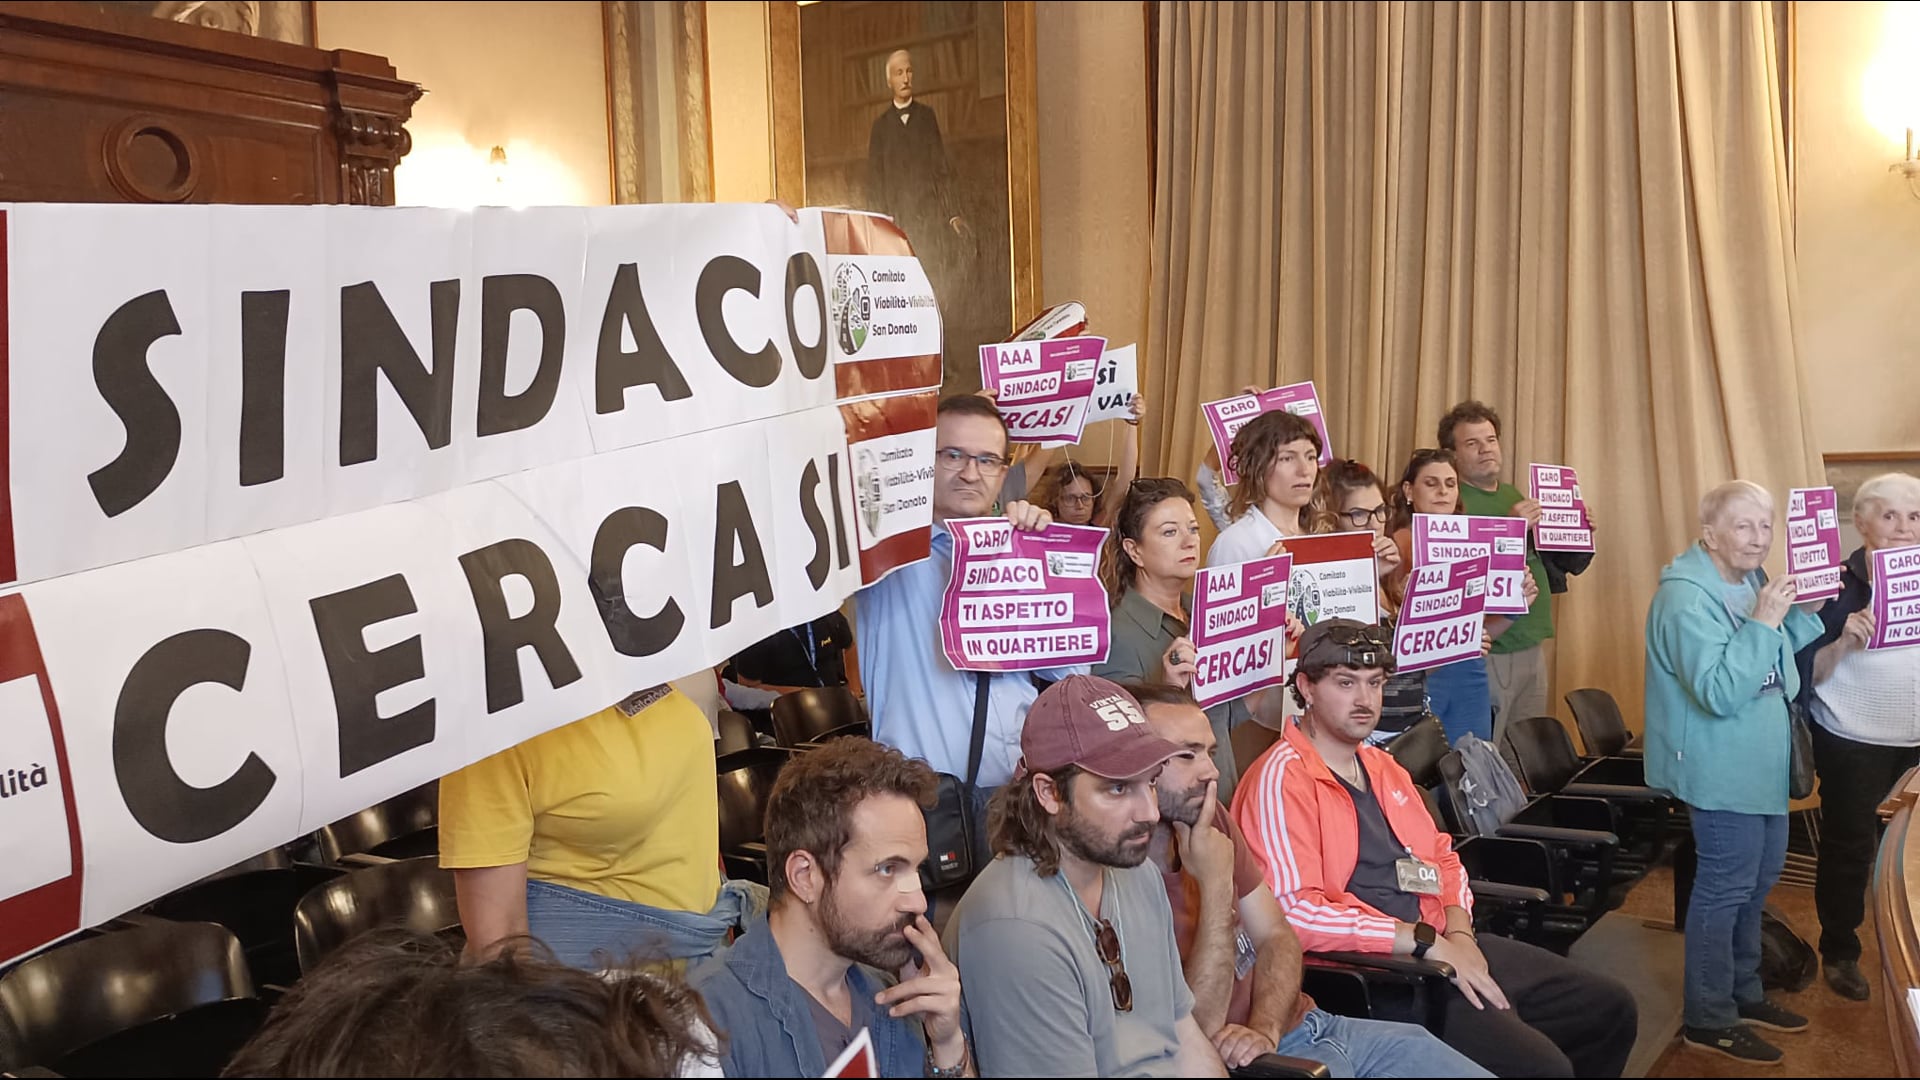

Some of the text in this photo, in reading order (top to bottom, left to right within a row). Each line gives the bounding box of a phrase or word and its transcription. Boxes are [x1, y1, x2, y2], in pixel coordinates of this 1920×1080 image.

[872, 270, 906, 282] Comitato
[872, 322, 918, 336] San Donato
[1000, 349, 1033, 366] AAA
[1096, 360, 1118, 385] SÌ
[86, 251, 828, 518] SINDACO
[1003, 377, 1057, 397] SINDACO
[1097, 392, 1132, 411] VA!
[1221, 400, 1256, 416] CARO
[1540, 472, 1559, 483] CARO
[1541, 492, 1571, 503] SINDACO
[1429, 520, 1461, 534] AAA
[973, 528, 1010, 550] CARO
[1431, 546, 1487, 559] SINDACO
[1889, 554, 1920, 570] CARO
[966, 565, 1040, 586] SINDACO
[1208, 571, 1236, 594] AAA
[1319, 571, 1347, 582] Comitato
[1416, 570, 1444, 586] AAA
[963, 600, 1068, 621] TI ASPETTO
[1323, 604, 1356, 616] San Donato
[1414, 593, 1460, 613] SINDACO
[1891, 605, 1904, 617] TI
[1208, 604, 1256, 630] SINDACO
[1400, 621, 1477, 656] CERCASI
[1888, 627, 1902, 639] IN
[112, 452, 852, 844] CERCASI
[966, 633, 1093, 656] IN QUARTIERE
[1195, 637, 1275, 688] CERCASI
[1095, 700, 1146, 731] 55
[1418, 867, 1437, 881] 04
